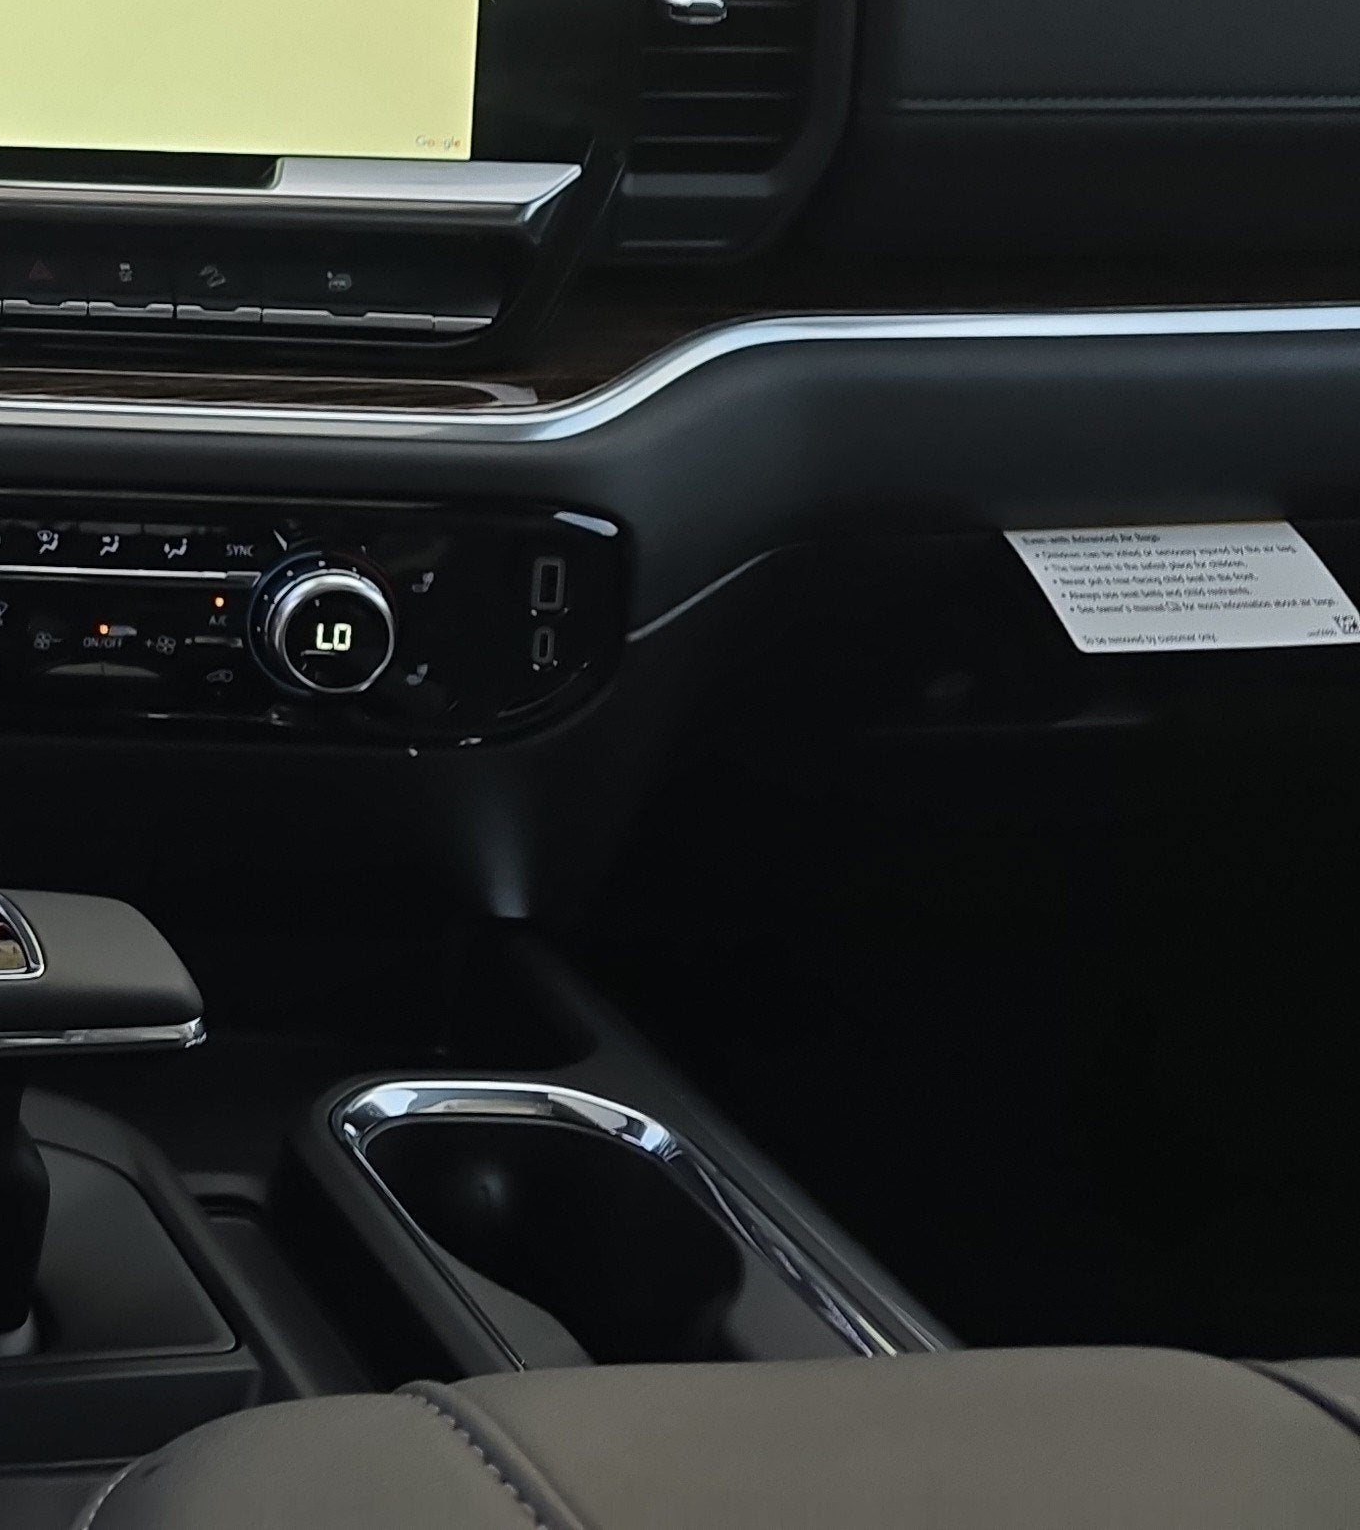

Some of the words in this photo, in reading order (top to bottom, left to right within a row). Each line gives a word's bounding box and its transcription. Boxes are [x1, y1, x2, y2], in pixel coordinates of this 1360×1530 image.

[415, 134, 461, 151] Gogle
[225, 543, 255, 558] SYNC
[316, 623, 352, 651] LO
